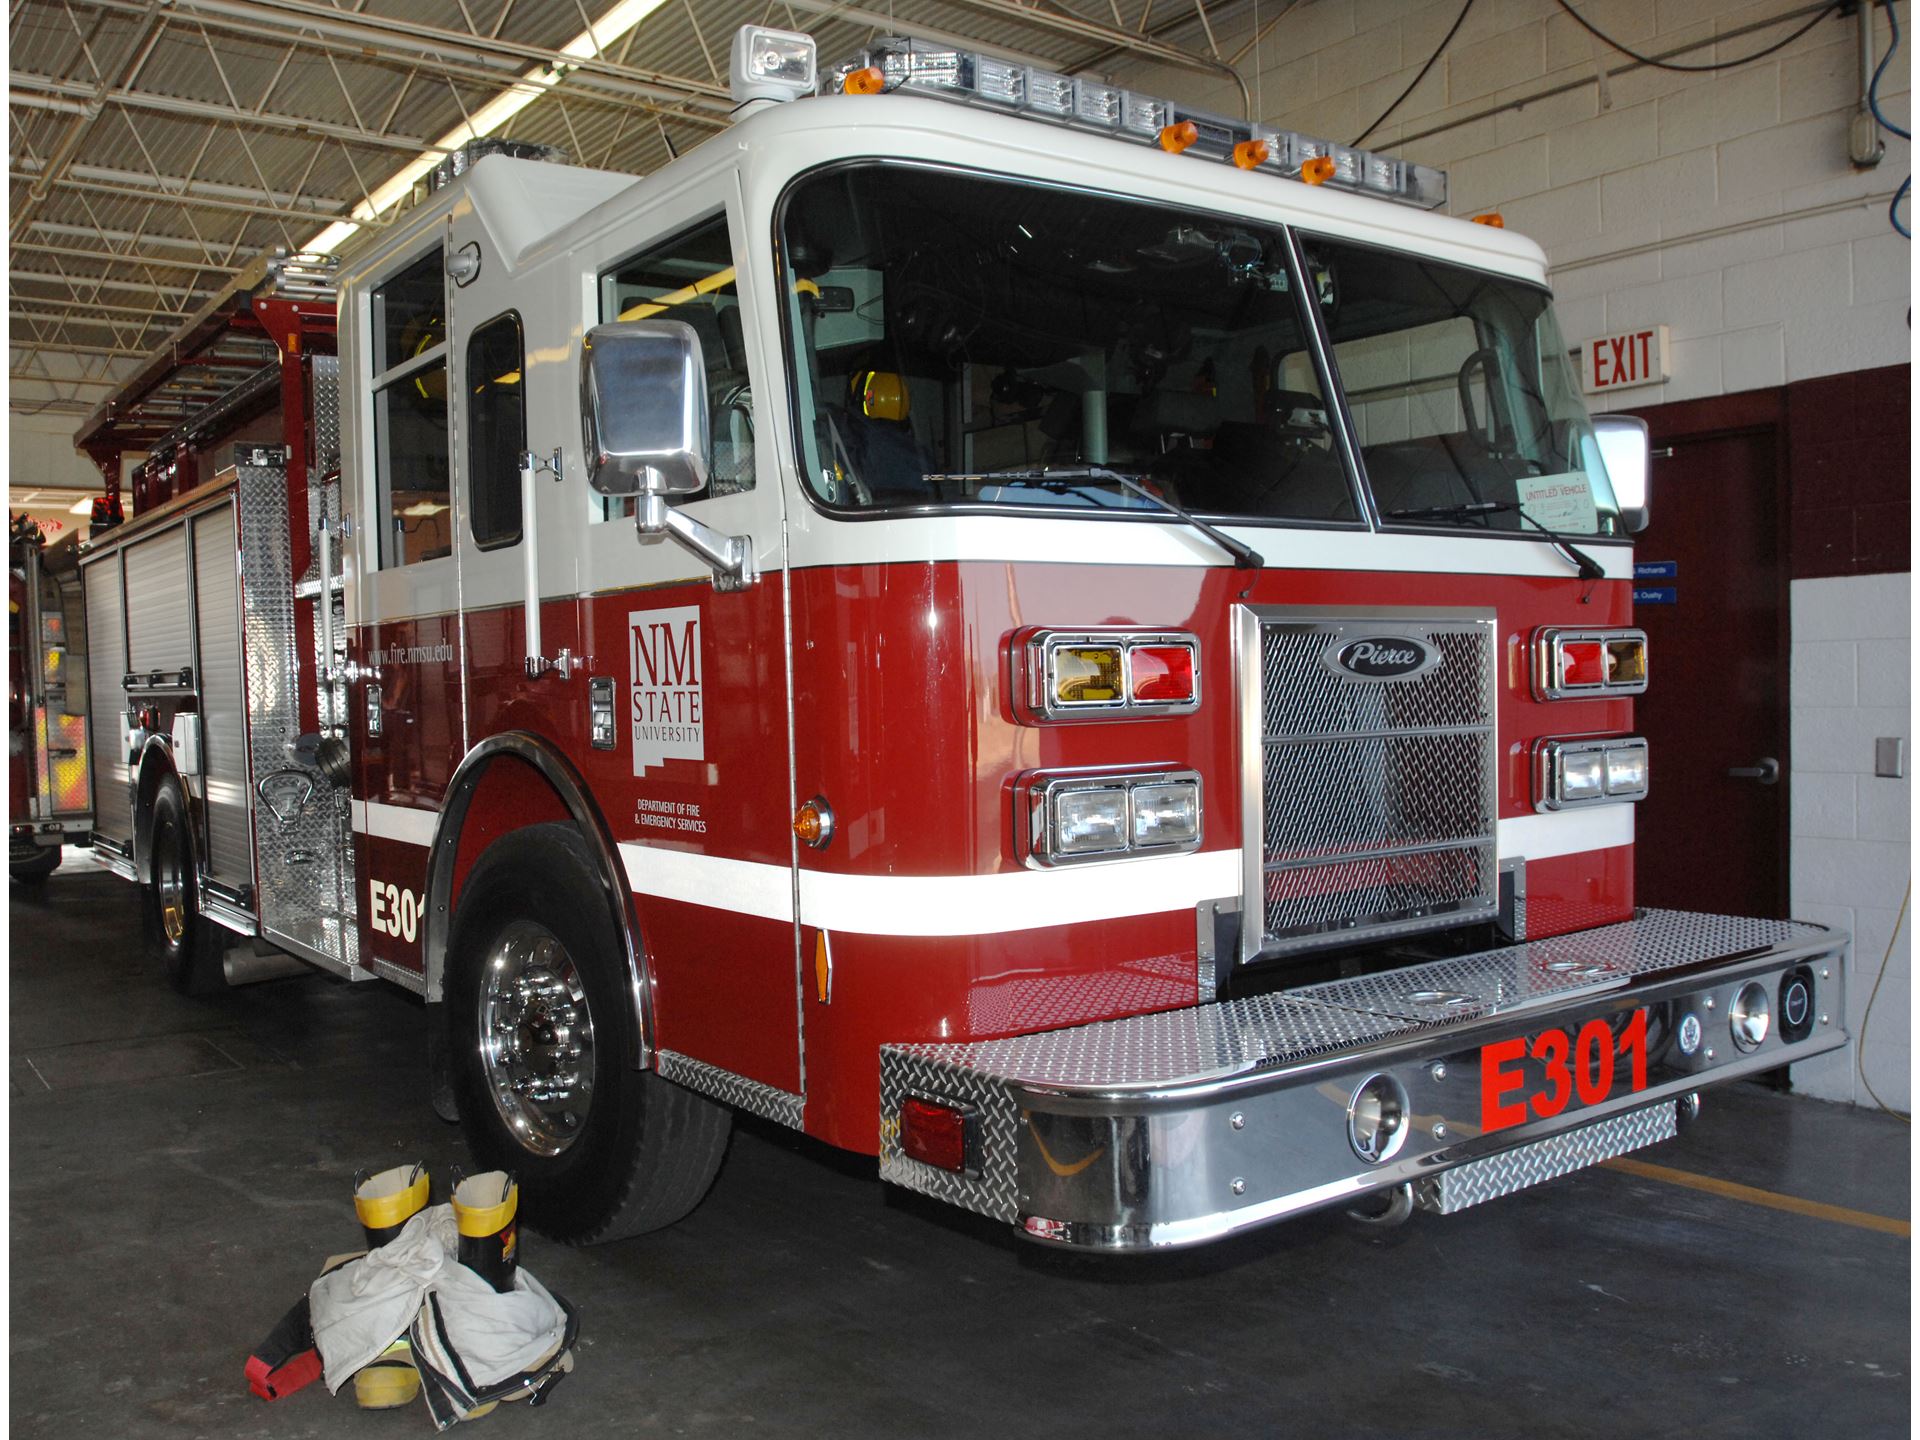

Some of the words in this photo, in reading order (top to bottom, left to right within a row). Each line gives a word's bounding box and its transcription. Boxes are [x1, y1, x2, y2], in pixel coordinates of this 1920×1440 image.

[1593, 331, 1653, 387] EXIT
[1526, 488, 1558, 501] UNTITLED
[1560, 483, 1587, 497] VEHICLE
[368, 638, 453, 665] www.fire.nmsu.edu
[631, 620, 699, 686] NM
[1348, 642, 1416, 669] Pierce
[633, 691, 700, 723] STATE
[634, 725, 700, 742] UNIVERSITY
[637, 799, 675, 814] DEPARTMENT
[677, 803, 685, 815] OF
[686, 804, 700, 817] FIRE
[634, 813, 640, 824] &
[641, 813, 676, 829] EMERGENCY
[677, 818, 707, 833] SERVICES
[1481, 1008, 1648, 1134] E301
